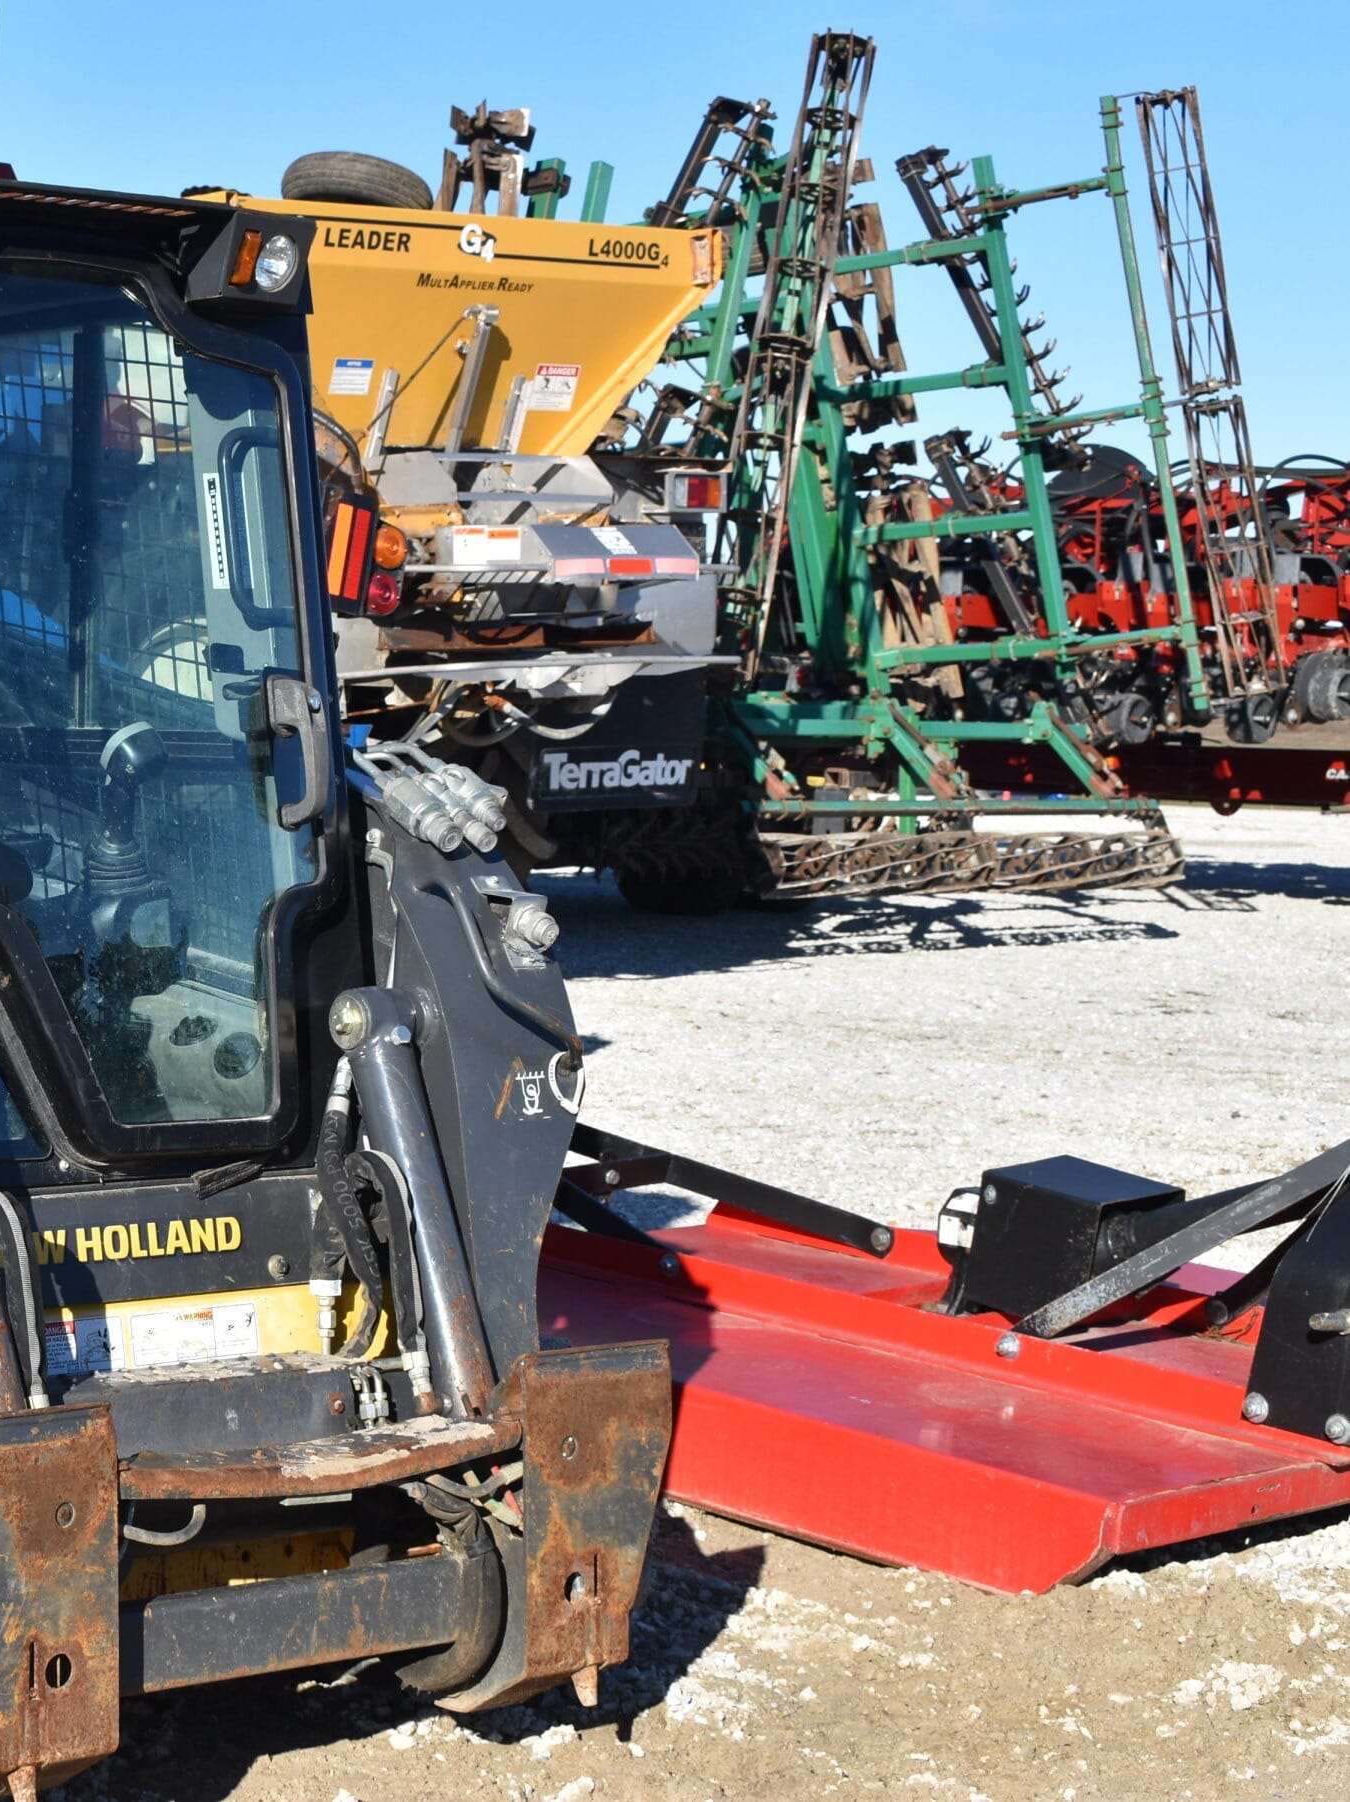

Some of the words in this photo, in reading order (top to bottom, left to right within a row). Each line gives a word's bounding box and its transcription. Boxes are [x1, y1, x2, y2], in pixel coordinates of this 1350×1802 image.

[324, 228, 411, 252] LEADER
[460, 223, 496, 263] G4
[543, 749, 694, 790] TerraGator
[332, 1180, 364, 1230] 5000
[75, 1216, 242, 1263] HOLLAND
